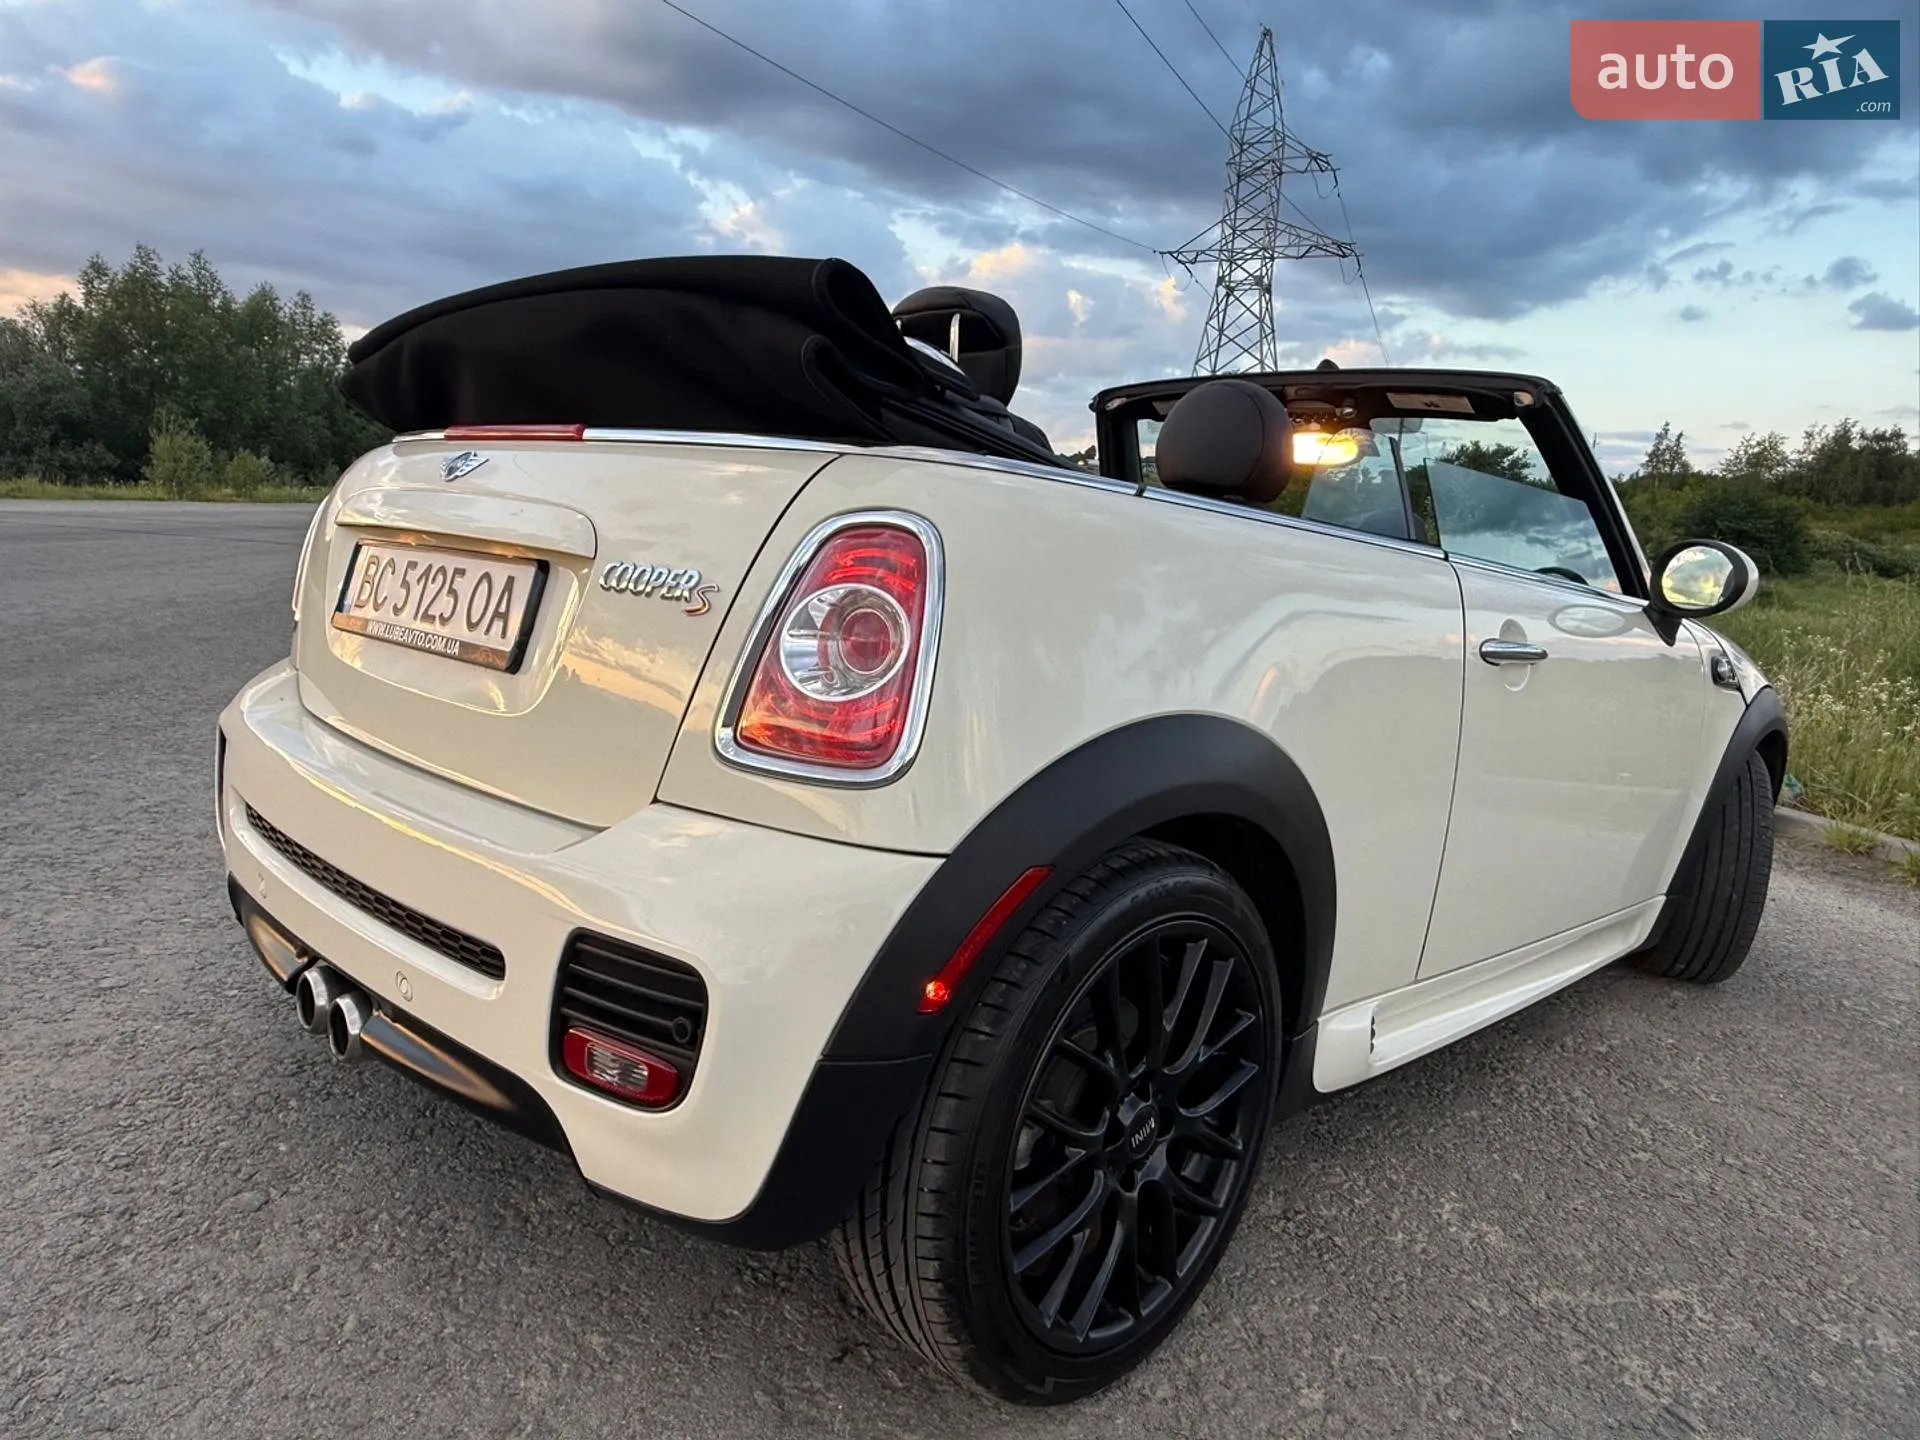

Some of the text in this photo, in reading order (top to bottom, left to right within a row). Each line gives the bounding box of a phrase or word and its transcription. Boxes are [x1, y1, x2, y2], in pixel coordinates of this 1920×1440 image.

[354, 554, 516, 640] BC 5125 OA
[598, 561, 702, 603] COOPER
[1130, 1116, 1155, 1149] MINI
